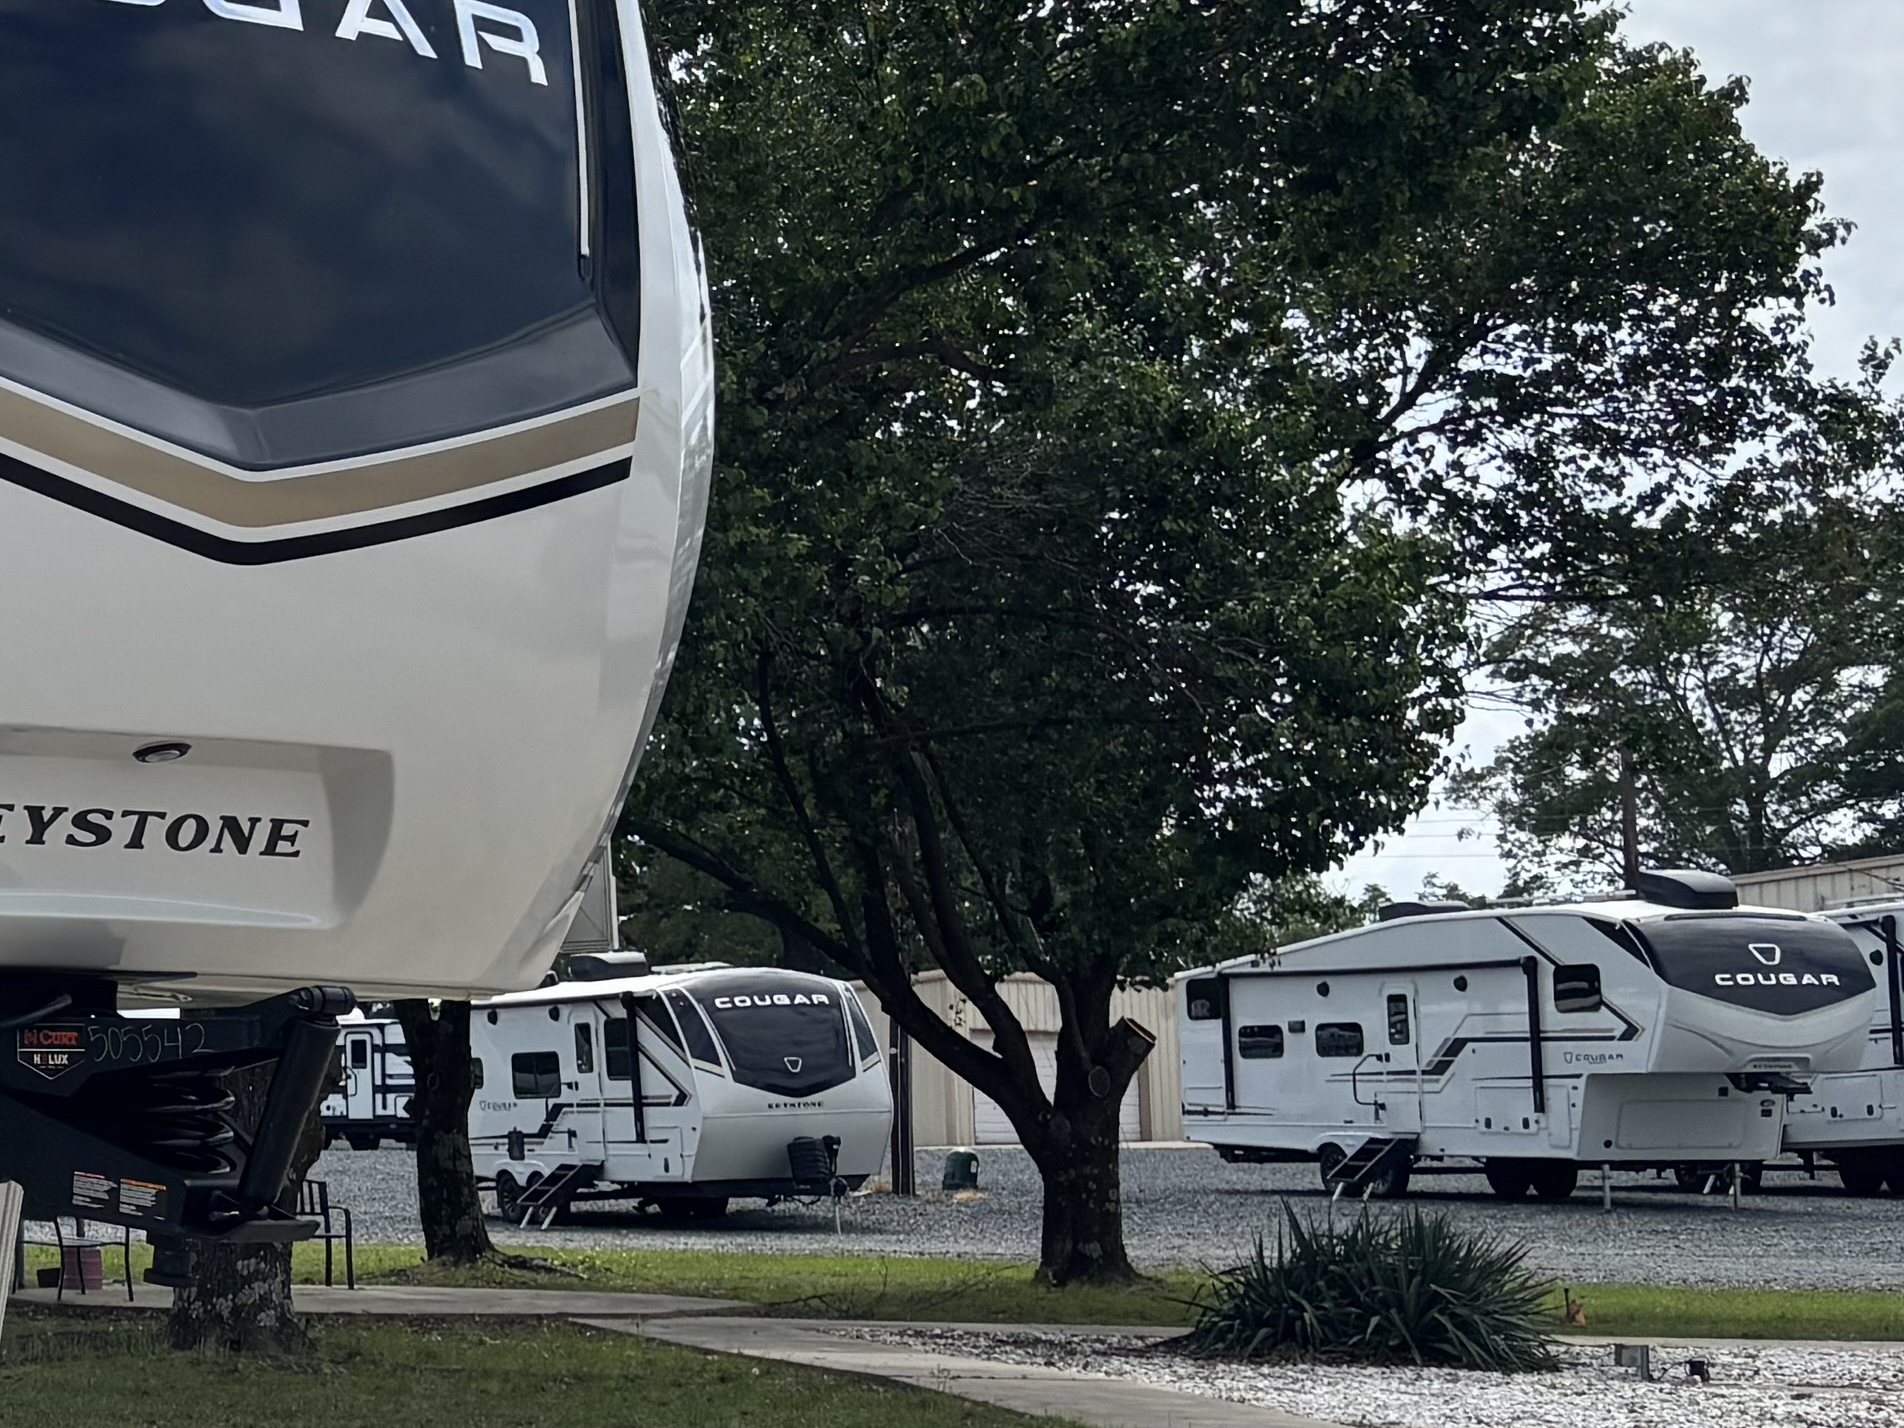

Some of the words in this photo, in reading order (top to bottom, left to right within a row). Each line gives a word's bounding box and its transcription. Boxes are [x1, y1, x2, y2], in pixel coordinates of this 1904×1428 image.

[1714, 973, 1841, 987] COUGAR
[714, 993, 830, 1009] COUGAR
[88, 1023, 220, 1062] 505542
